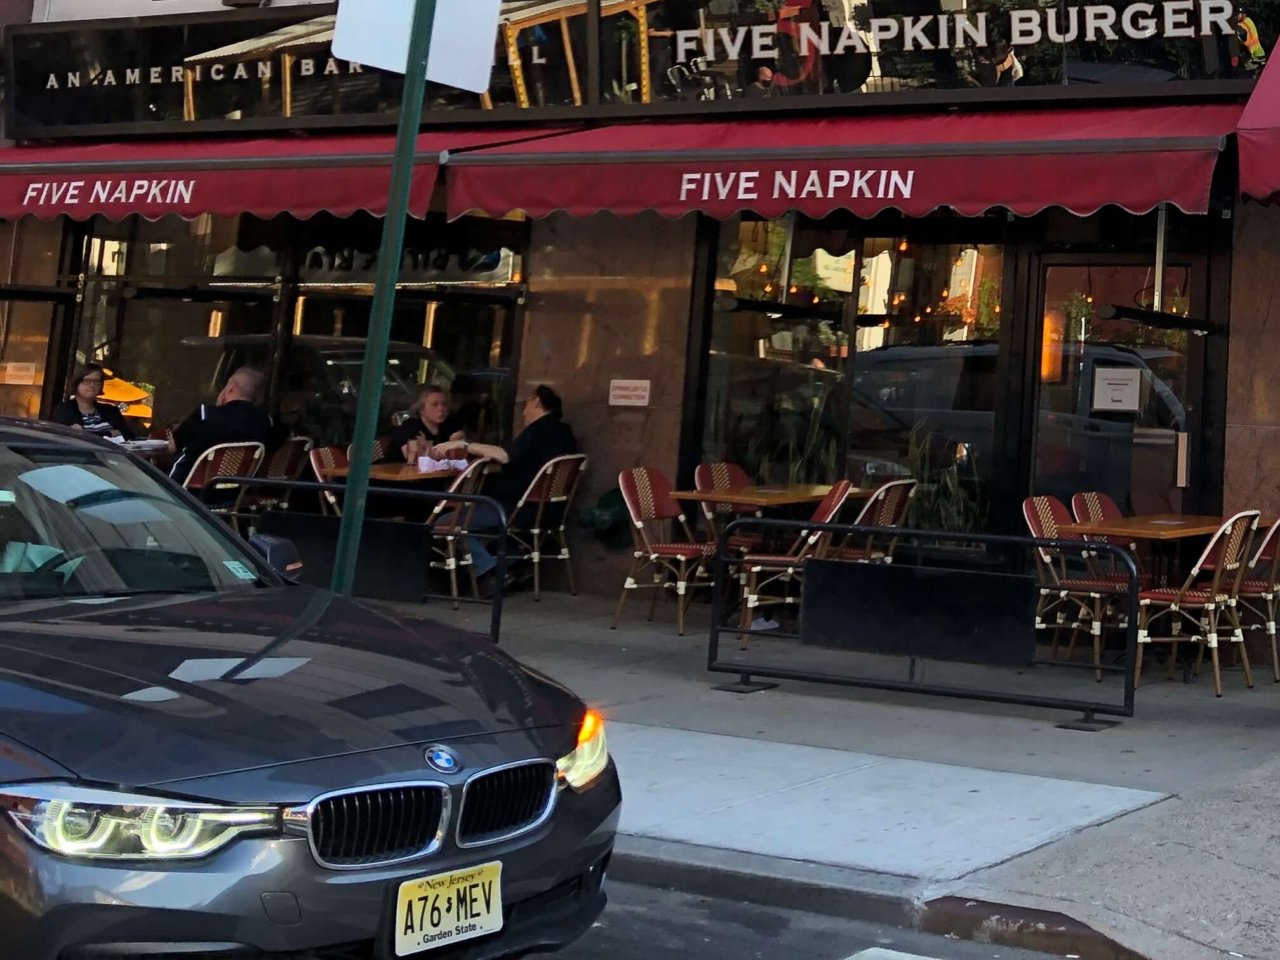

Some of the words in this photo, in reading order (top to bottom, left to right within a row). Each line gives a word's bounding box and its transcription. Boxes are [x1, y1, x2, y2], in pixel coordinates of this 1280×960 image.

[676, 24, 779, 64] FIVE
[799, 12, 987, 57] NAPKIN
[46, 72, 80, 89] AN
[103, 61, 272, 86] AMERICAN
[301, 58, 363, 76] BAR
[22, 181, 85, 206] FIVE
[88, 179, 196, 204] NAPKIN
[679, 171, 760, 201] FIVE
[772, 170, 915, 199] NAPKIN
[423, 880, 445, 892] New
[447, 872, 476, 889] Jersey
[403, 893, 442, 936] A76
[456, 879, 493, 922] MEV
[422, 929, 453, 944] Garden
[455, 922, 477, 936] State
